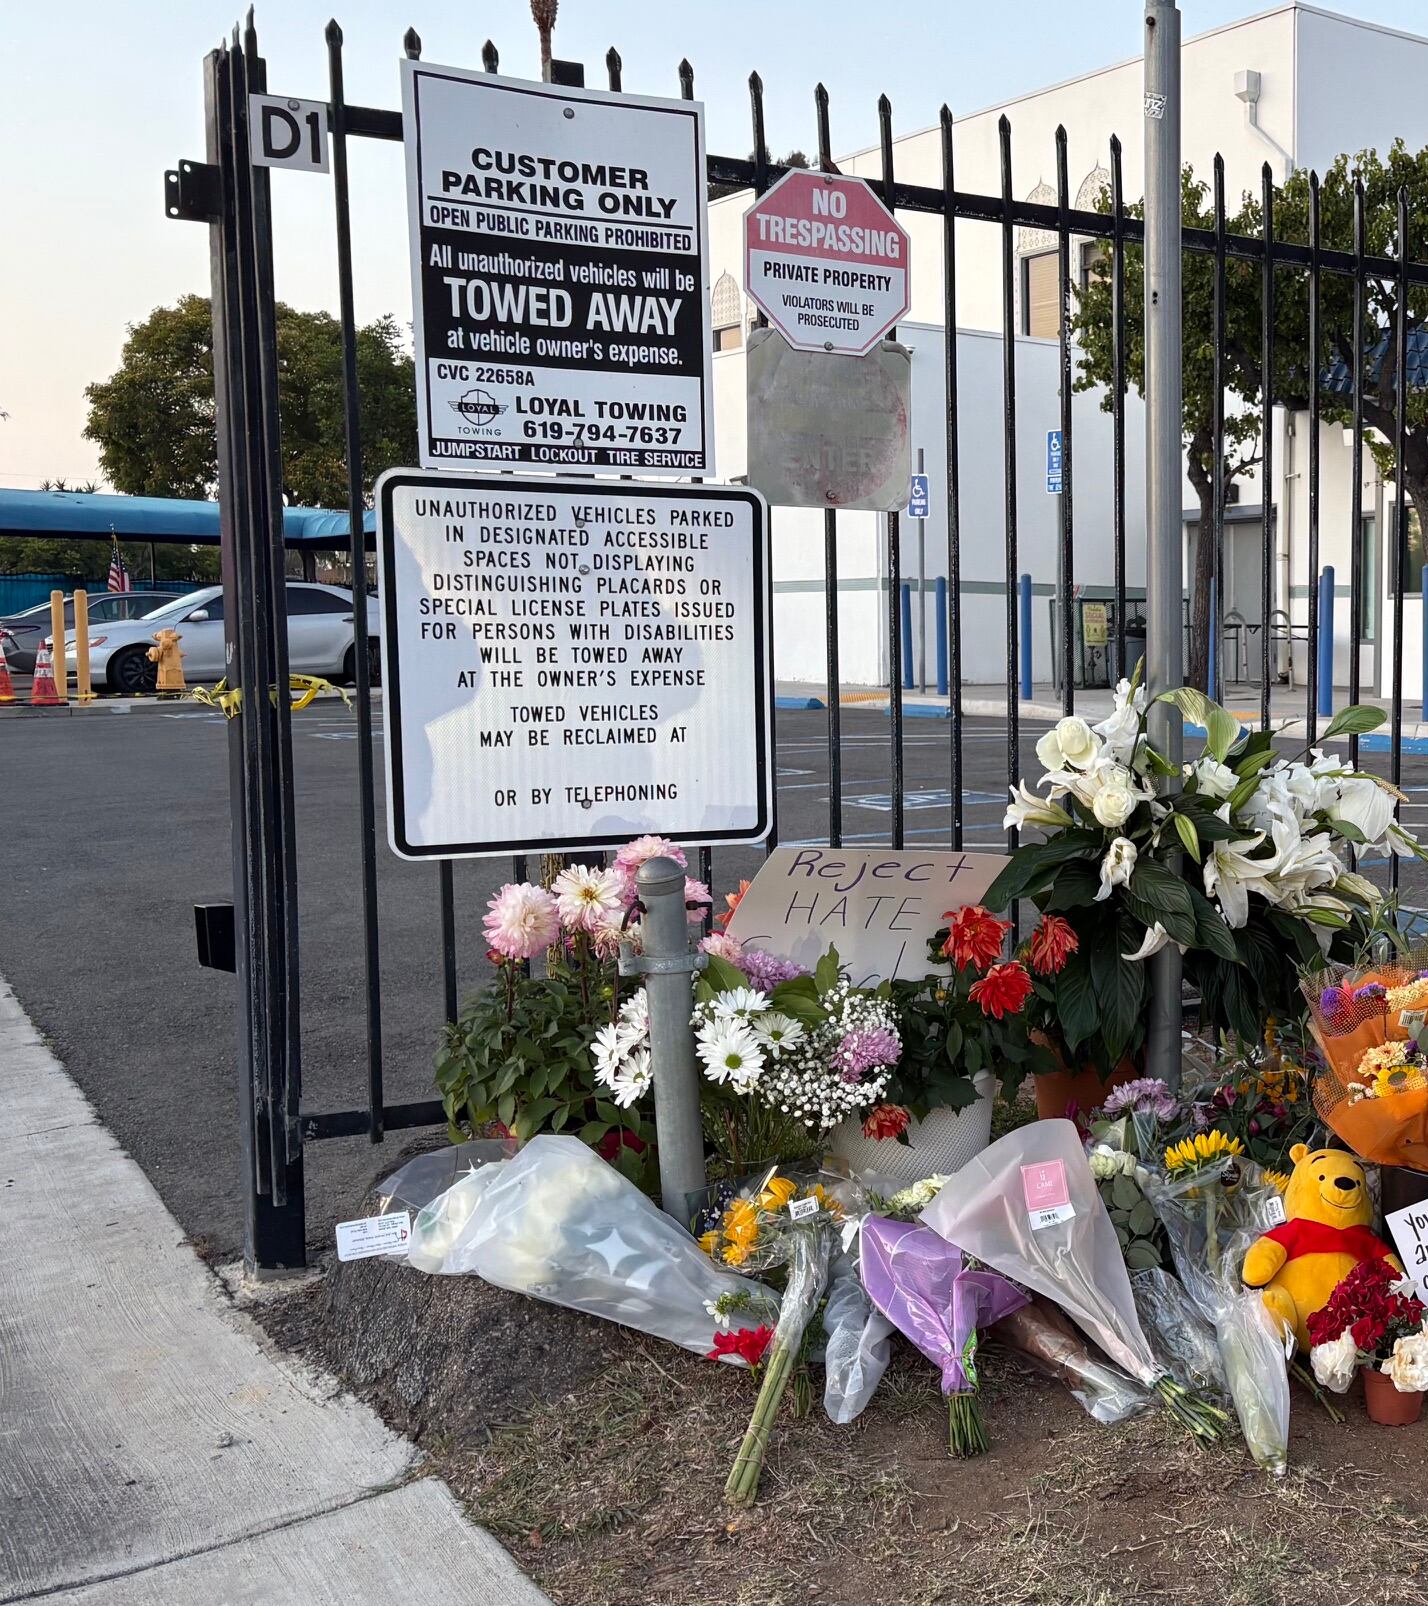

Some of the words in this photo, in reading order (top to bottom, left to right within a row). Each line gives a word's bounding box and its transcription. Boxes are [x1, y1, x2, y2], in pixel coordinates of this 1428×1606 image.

[262, 105, 321, 164] D1
[471, 147, 649, 191] CUSTOMER
[442, 170, 584, 211] PARKING
[598, 192, 678, 219] ONLY
[812, 188, 846, 218] NO
[430, 205, 470, 228] OPEN
[476, 211, 529, 236] PUBLIC
[535, 220, 598, 243] PARKING
[605, 227, 691, 251] PROHIBITED
[756, 212, 900, 259] TRESPASSING
[430, 243, 451, 268] All
[458, 251, 564, 281] unauthorized
[570, 263, 637, 288] vehicles
[642, 267, 669, 290] will
[675, 270, 695, 292] be
[763, 261, 818, 283] PRIVATE
[823, 268, 892, 292] PROPERTY
[443, 276, 573, 328] TOWED
[586, 292, 682, 336] AWAY
[782, 294, 834, 312] VIOLATORS
[837, 300, 860, 315] WILL
[862, 304, 875, 316] BE
[798, 312, 860, 331] PROSECUTED
[447, 327, 464, 349] at
[470, 330, 530, 354] vehicle
[536, 340, 603, 360] owner's
[609, 344, 684, 367] expense.
[437, 363, 469, 381] CVC
[475, 366, 535, 386] 22658A
[462, 403, 496, 414] LOYAL
[515, 396, 585, 417] LOYAL
[594, 400, 688, 422] TOWING
[457, 426, 502, 437] TOWING
[523, 420, 683, 445] 619-794-7637
[432, 441, 522, 460] JUMPSTART
[531, 446, 598, 463] LOCKOUT
[606, 450, 640, 466] TIRE
[644, 452, 703, 468] SERVICE
[415, 499, 557, 521] UNAUTHORIZED
[571, 505, 656, 525] VEHICLES
[670, 510, 734, 527] PARKED
[445, 526, 464, 542] IN
[480, 526, 589, 547] DESIGNATED
[604, 531, 709, 550] ACCESSIBLE
[463, 551, 531, 568] SPACES
[545, 552, 579, 569] NOT
[593, 554, 695, 572] DISPLAYING
[433, 574, 582, 593] DISTINGUISHING
[597, 577, 687, 595] PLACARDS
[699, 579, 721, 595] OR
[419, 598, 497, 616] SPECIAL
[511, 599, 586, 617] LICENSE
[600, 601, 661, 618] PLATES
[674, 602, 735, 619] ISSUED
[421, 623, 457, 640] FOR
[472, 623, 555, 641] PERSONS
[569, 624, 610, 641] WITH
[624, 624, 734, 641] DISABILITIES
[480, 647, 522, 664] WILL
[536, 647, 559, 663] BE
[571, 647, 628, 663] TOWED
[641, 647, 684, 663] AWAY
[457, 671, 477, 688] AT
[490, 671, 523, 687] THE
[537, 670, 617, 687] OWNER'S
[630, 670, 705, 686] EXPENSE
[510, 706, 566, 723] TOWED
[579, 704, 659, 721] VEHICLES
[480, 730, 513, 748] MAY
[528, 730, 550, 746] BE
[563, 727, 657, 745] RECLAIMED
[670, 726, 687, 743] AT
[494, 790, 517, 807] OR
[531, 788, 552, 805] BY
[565, 784, 678, 803] TELEPHONING
[787, 849, 974, 892] Reject
[784, 891, 922, 931] HATE
